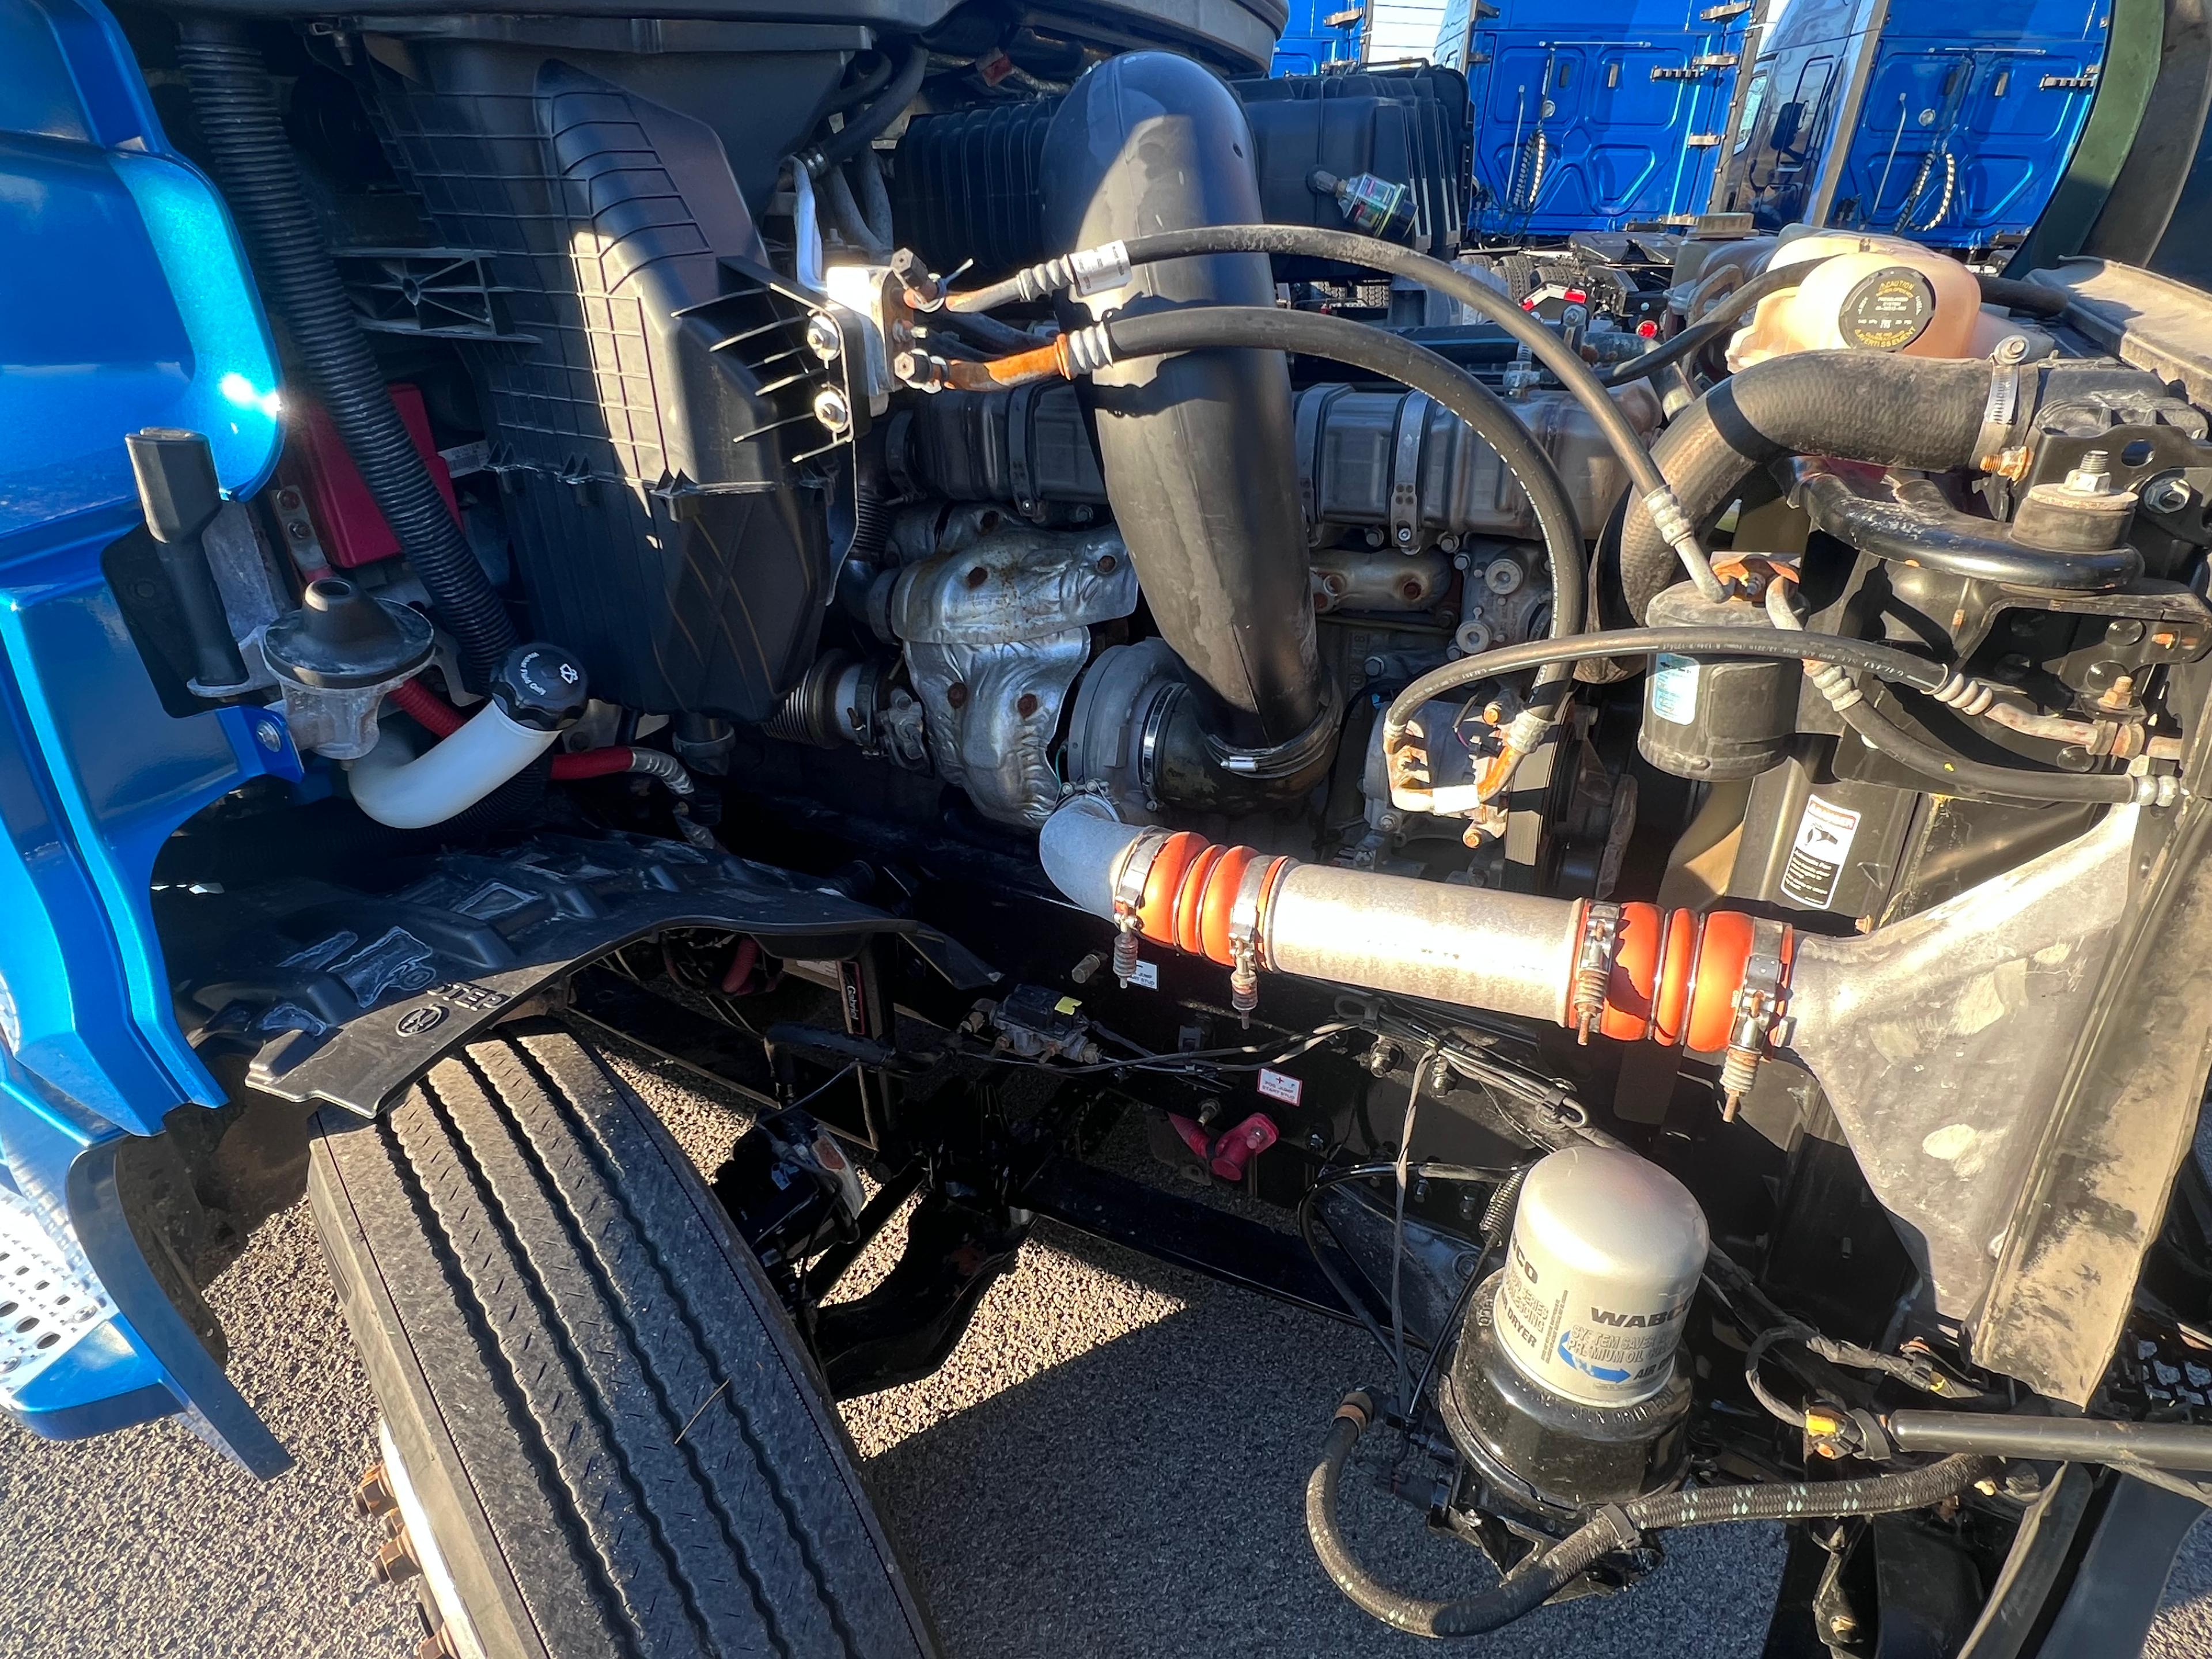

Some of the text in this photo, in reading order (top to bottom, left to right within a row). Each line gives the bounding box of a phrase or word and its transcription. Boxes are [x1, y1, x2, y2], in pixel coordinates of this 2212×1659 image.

[1885, 280, 1914, 290] CAUTION
[426, 982, 504, 1012] STEP
[847, 986, 859, 1020] Gabriel
[1262, 1085, 1295, 1100] START STUD
[1512, 1232, 1539, 1284] BCO
[1590, 1294, 1692, 1328] WABCO
[1508, 1306, 1537, 1348] DRYER
[1625, 1349, 1643, 1363] OIL
[1633, 1363, 1657, 1381] AIR
